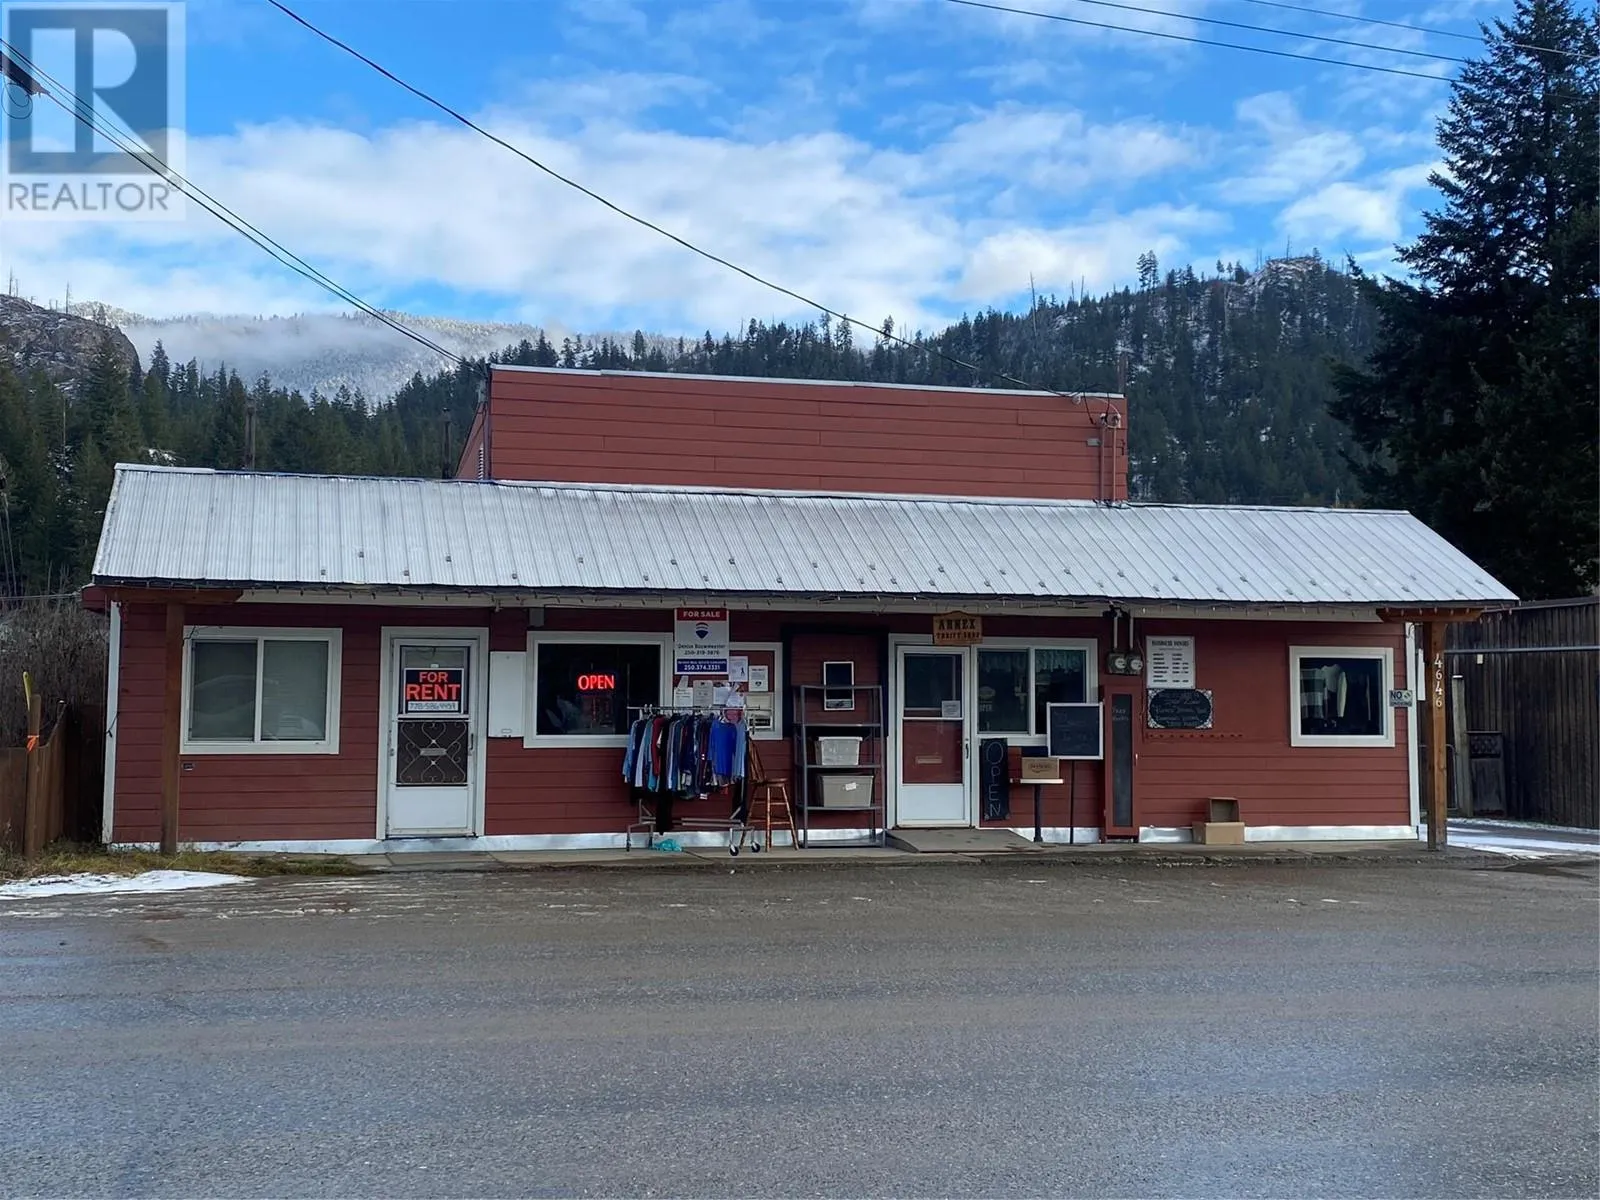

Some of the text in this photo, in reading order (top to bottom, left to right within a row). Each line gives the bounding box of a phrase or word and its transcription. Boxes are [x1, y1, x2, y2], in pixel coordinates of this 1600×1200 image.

[938, 618, 976, 630] ANNEX
[419, 671, 449, 683] FOR
[578, 674, 615, 690] OPEN
[1434, 653, 1443, 708] 4646
[406, 684, 461, 701] RENT
[1390, 691, 1403, 700] NO
[986, 741, 1004, 817] OPEN
